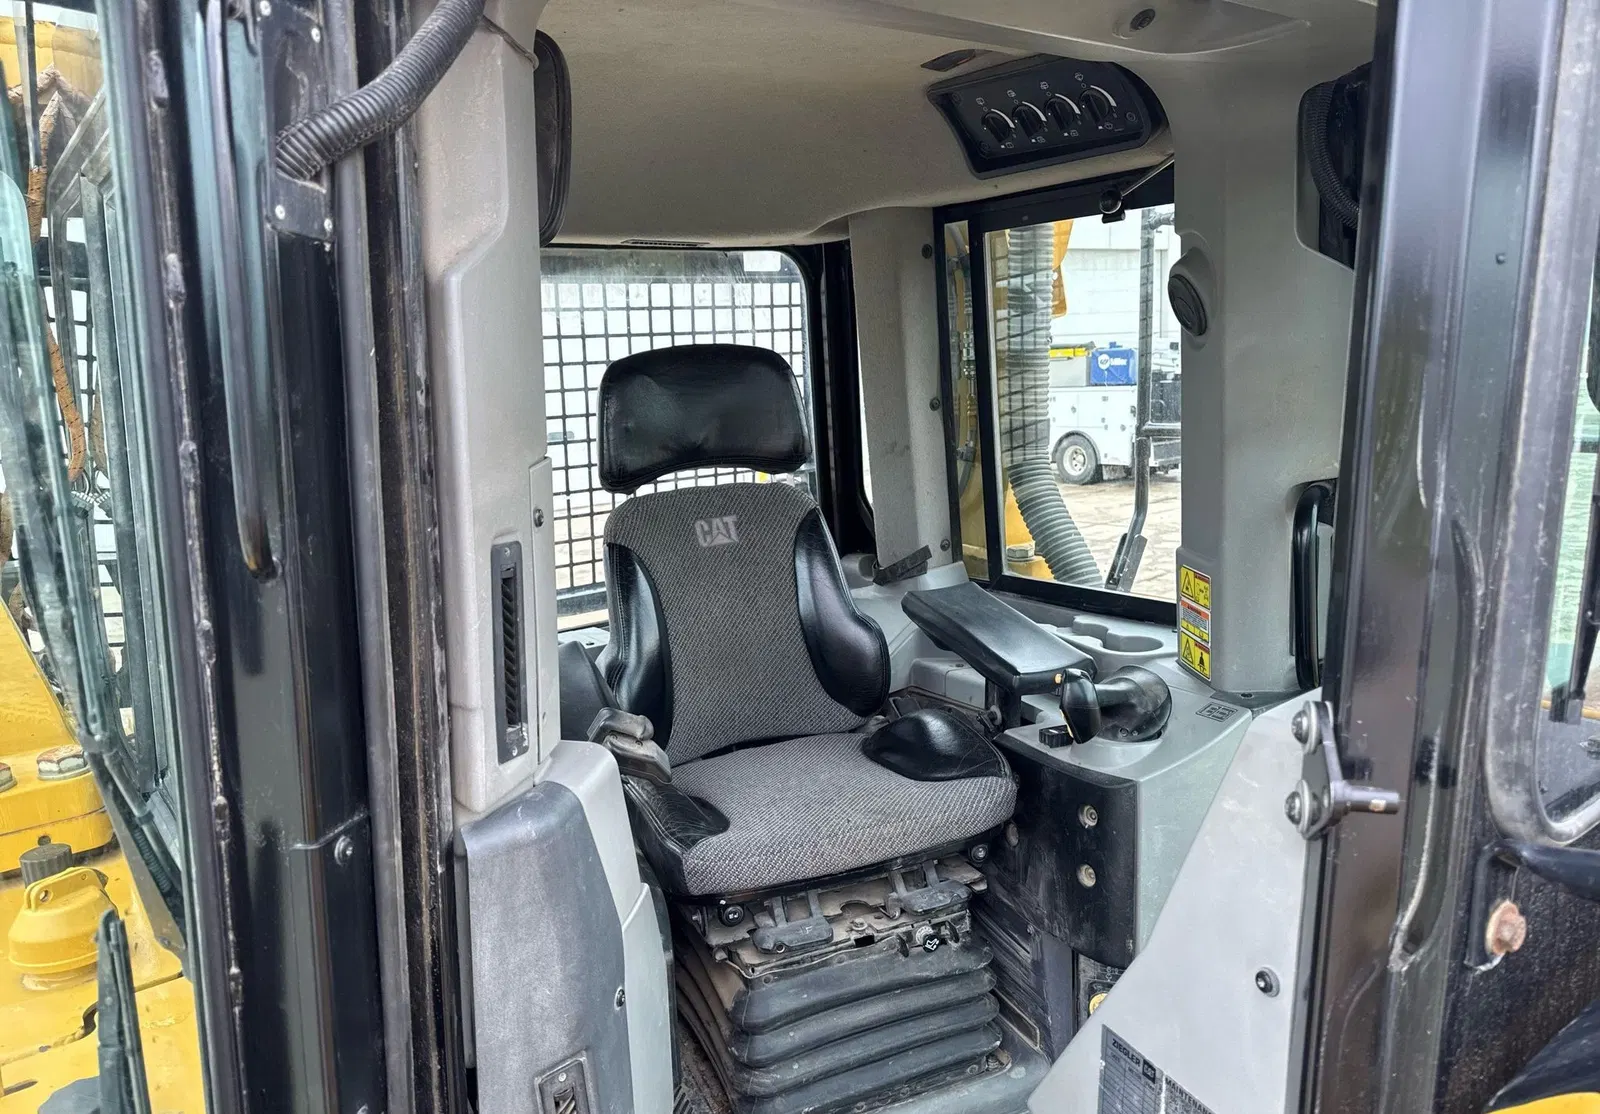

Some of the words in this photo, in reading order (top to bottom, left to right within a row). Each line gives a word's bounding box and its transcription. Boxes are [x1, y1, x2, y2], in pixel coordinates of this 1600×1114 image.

[694, 514, 740, 547] CAT
[1112, 1038, 1141, 1067] ZIEGLER
[1165, 1077, 1212, 1114] MAINTENAN
